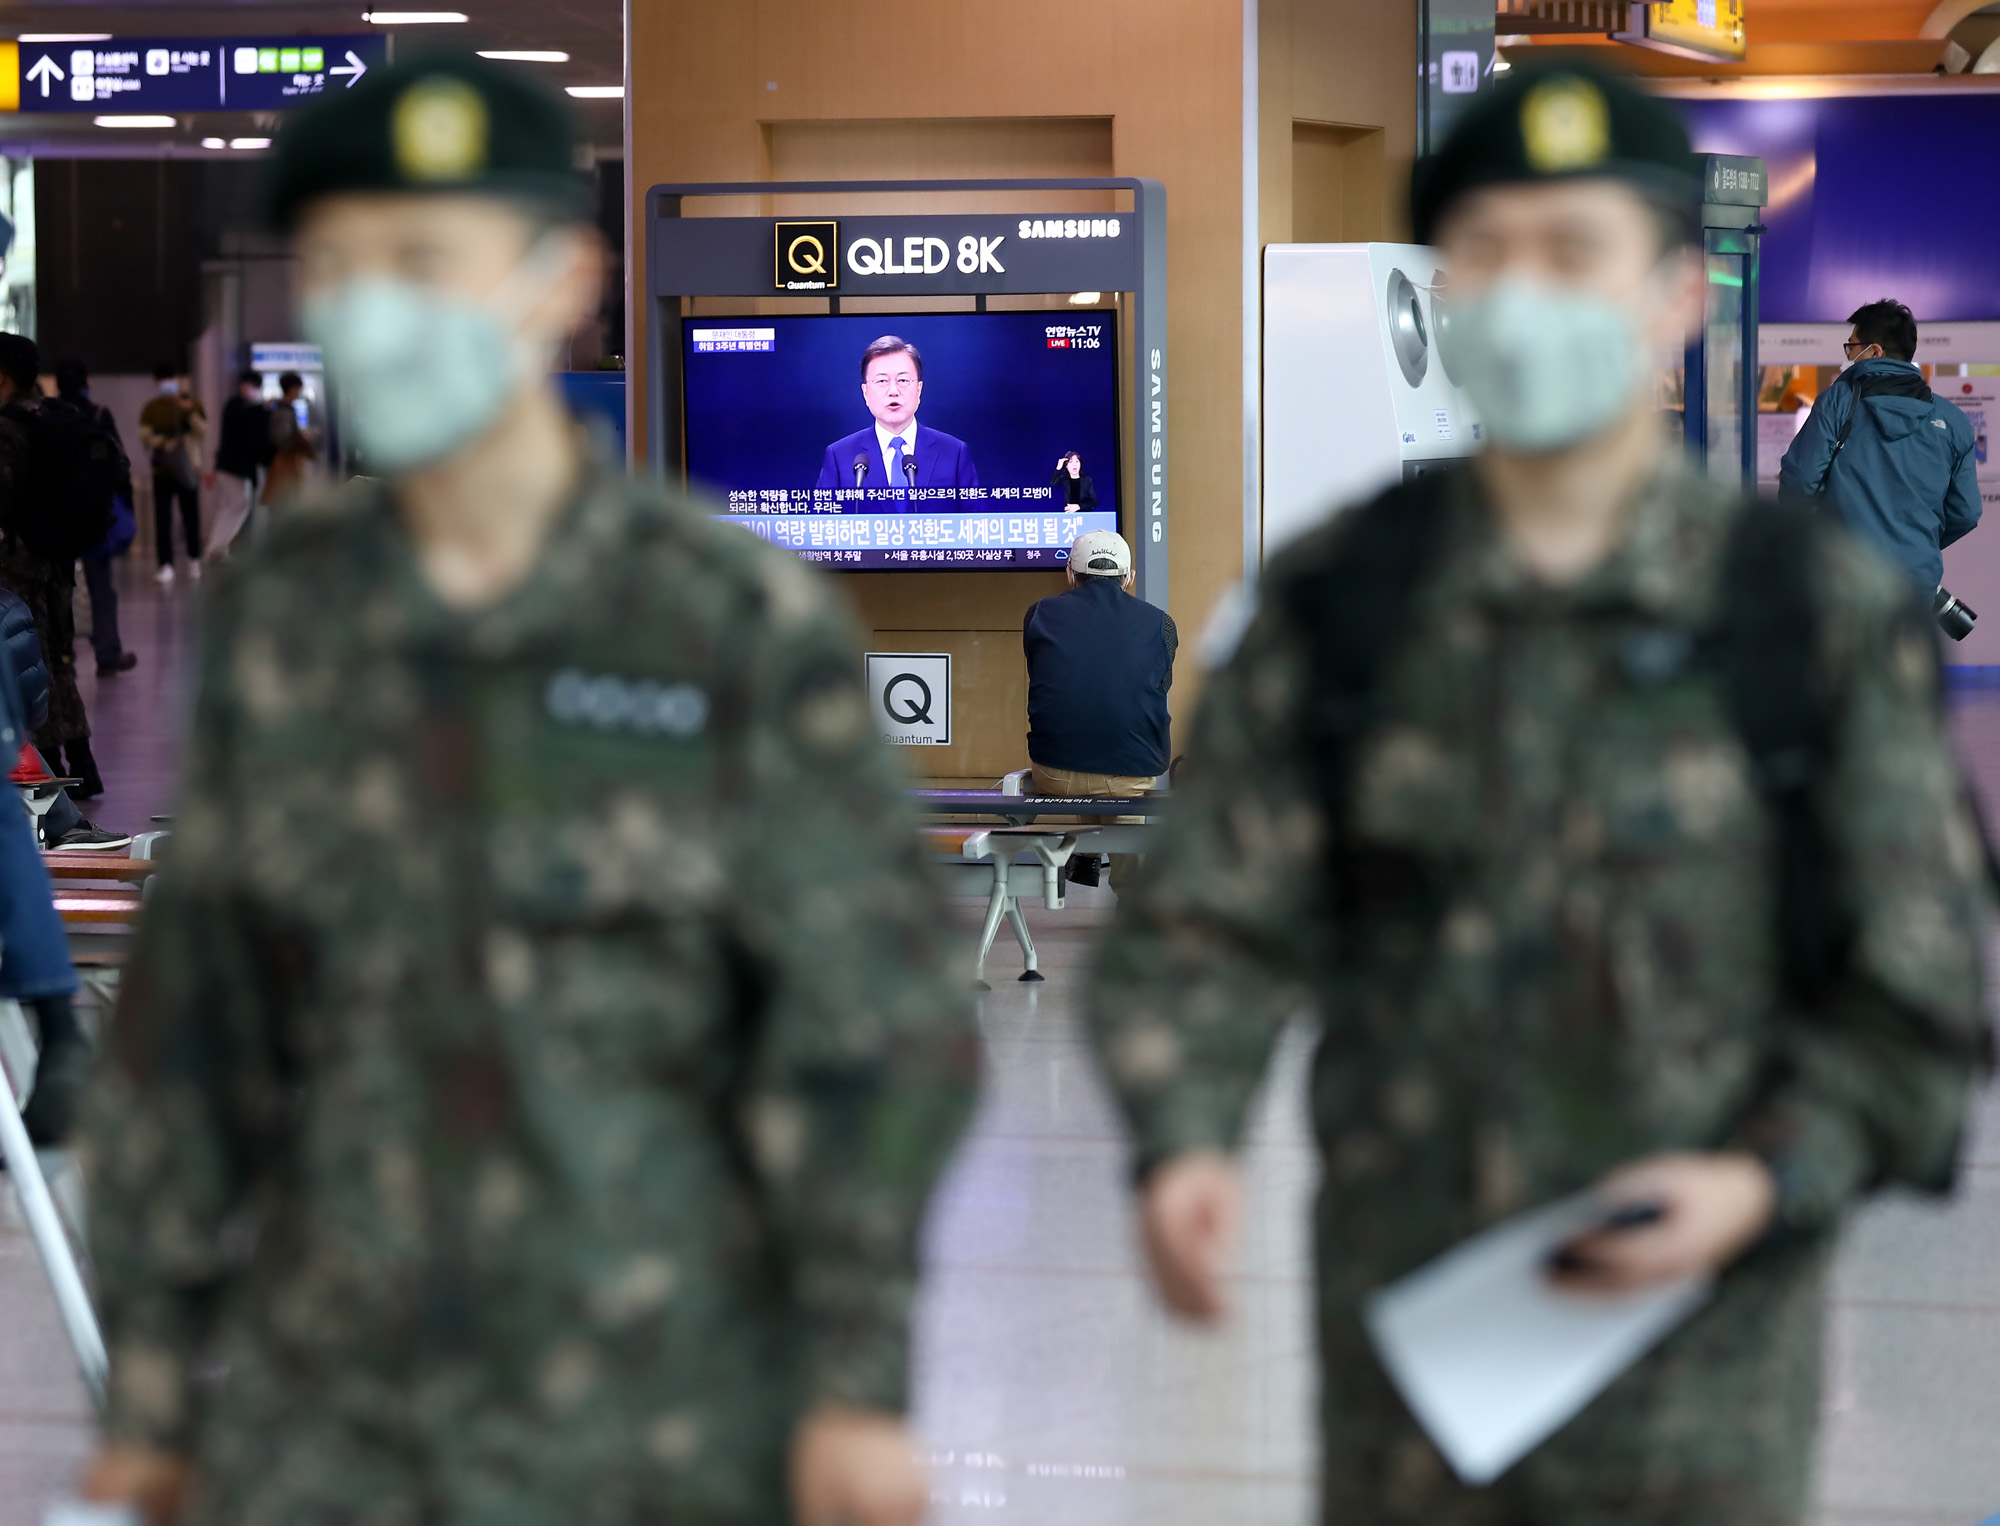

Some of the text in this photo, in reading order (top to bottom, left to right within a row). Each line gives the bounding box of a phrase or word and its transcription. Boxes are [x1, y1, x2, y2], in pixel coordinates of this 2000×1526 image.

[1018, 219, 1121, 239] SAMSUNG
[788, 235, 827, 274] Q
[847, 236, 1006, 275] QLED 8K
[787, 280, 825, 290] Quantum
[712, 330, 756, 340] 문재인 대통령
[1045, 325, 1101, 338] 연합뉴스TV
[698, 340, 770, 351] 취임 3주년 특별연설
[1070, 337, 1100, 349] 11:06
[1151, 348, 1162, 543] SAMSUNG
[728, 487, 1052, 501] 성숙한 역량을 다시 한번 발휘해 주신다면 일상으로의 전환도 세계의 모범이
[729, 502, 842, 514] 되리라 확신합니다. 우리는
[775, 520, 806, 546] 역량
[809, 519, 870, 546] 발휘하면
[874, 519, 905, 546] 일상
[908, 518, 955, 545] 전환도
[958, 518, 1004, 545] 세계의
[1007, 517, 1039, 545] 모범
[1043, 517, 1059, 544] 될
[833, 550, 843, 561] 첫
[844, 550, 862, 561] 주말
[891, 550, 908, 561] 서울
[910, 550, 945, 561] 유흥시설
[946, 550, 974, 562] 2,150곳
[976, 550, 1002, 561] 사실상
[1026, 550, 1041, 560] 청주
[883, 673, 935, 724] Q
